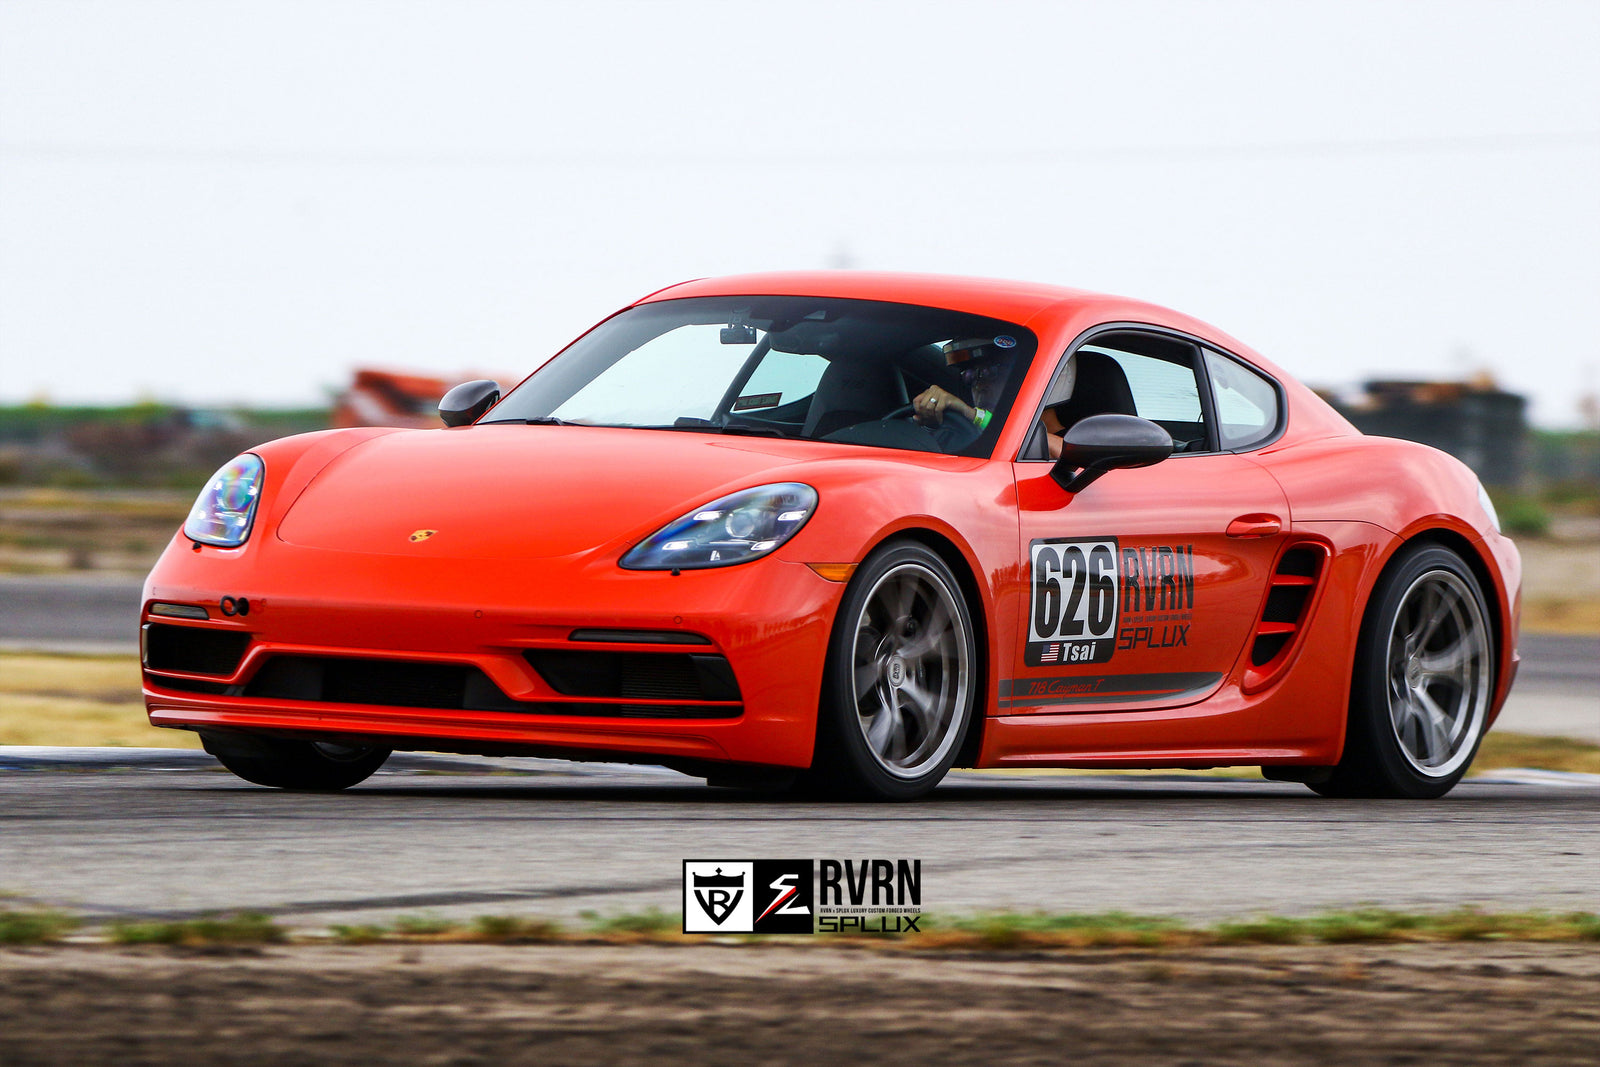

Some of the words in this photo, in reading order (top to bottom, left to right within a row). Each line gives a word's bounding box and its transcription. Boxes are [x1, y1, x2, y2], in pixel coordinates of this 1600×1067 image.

[1035, 545, 1115, 638] 626
[1122, 545, 1194, 612] RVRN
[1118, 624, 1190, 650] SPLUX
[1062, 641, 1096, 662] Tsai
[1028, 681, 1048, 694] 718
[1048, 680, 1092, 699] Cayman
